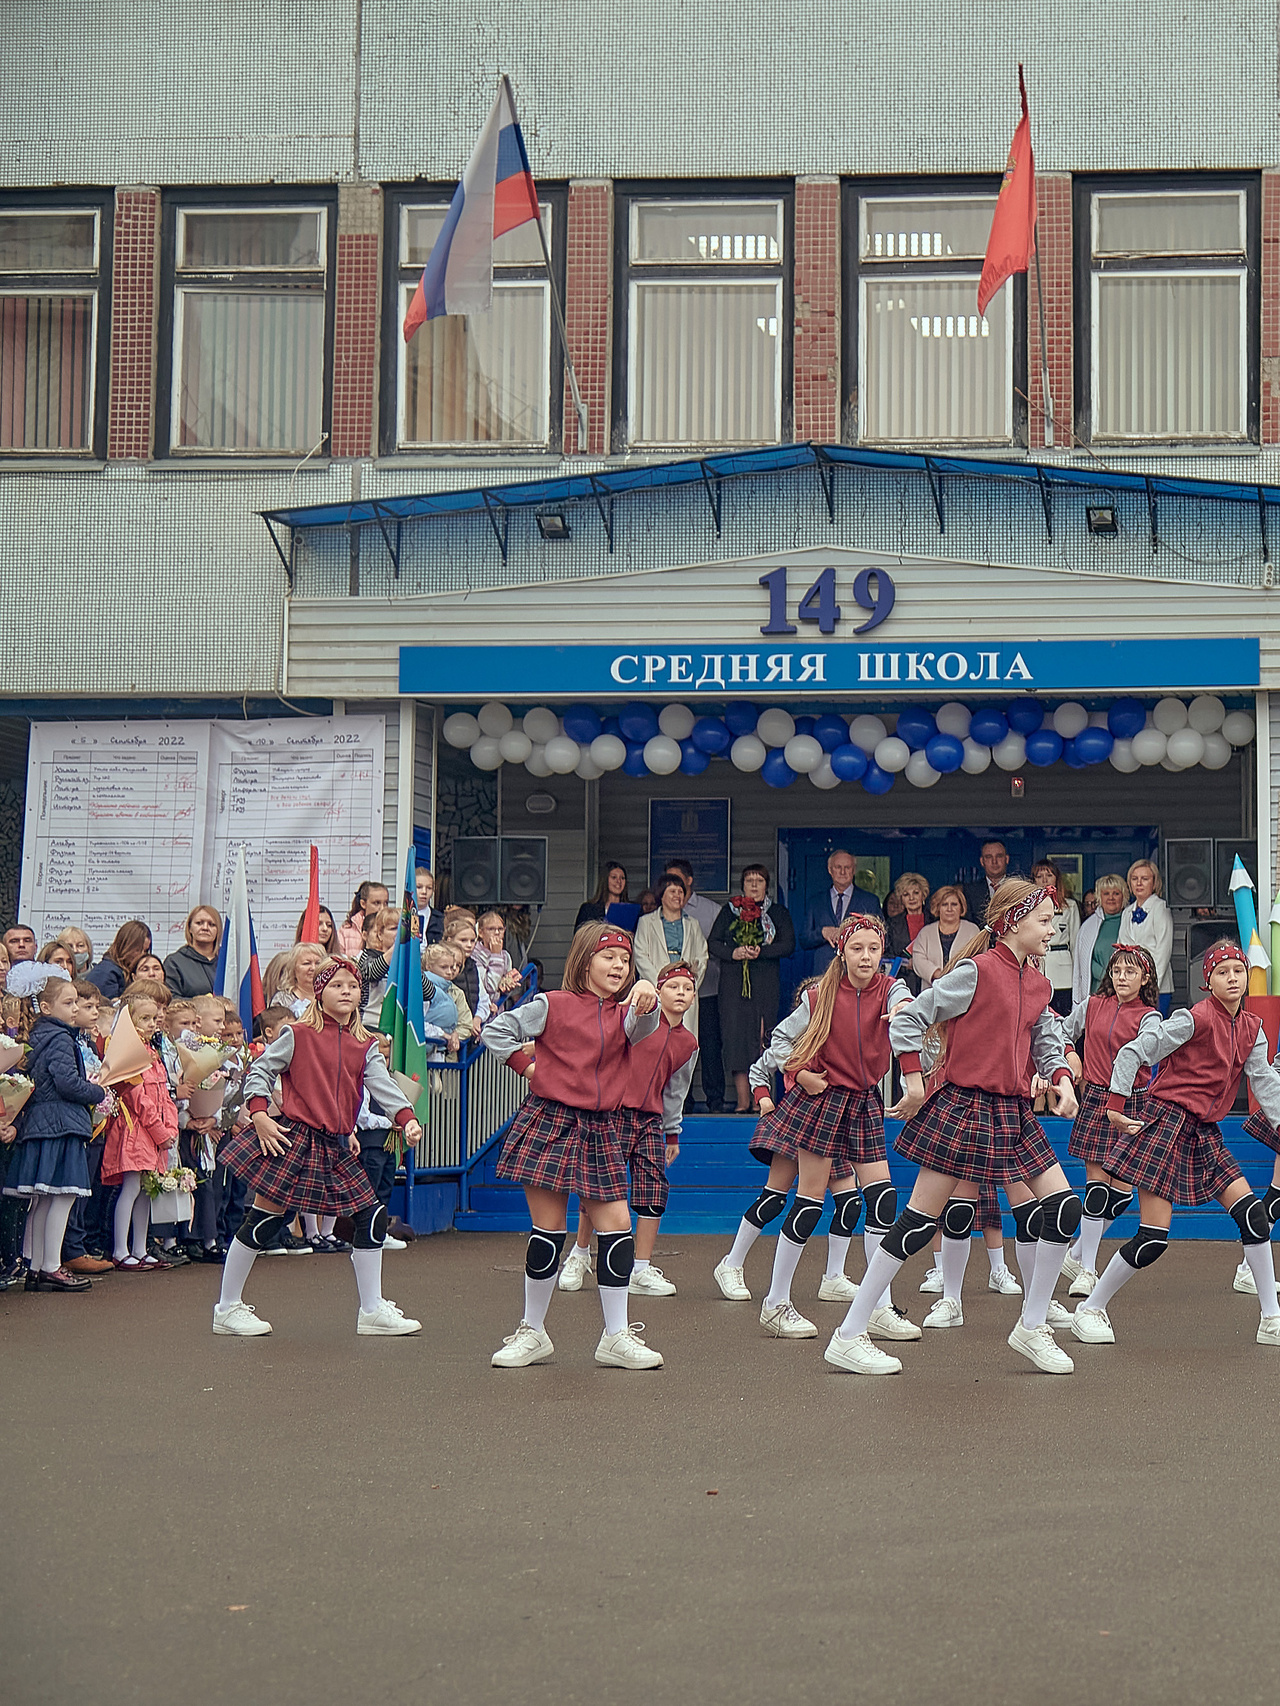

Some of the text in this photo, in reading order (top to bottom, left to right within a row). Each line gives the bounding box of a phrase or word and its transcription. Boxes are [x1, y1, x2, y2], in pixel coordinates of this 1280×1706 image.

[757, 566, 896, 636] 149
[610, 650, 1035, 692] СРЕДНЯЯ ШКОЛА
[158, 736, 186, 746] 2022
[333, 734, 361, 744] 2022
